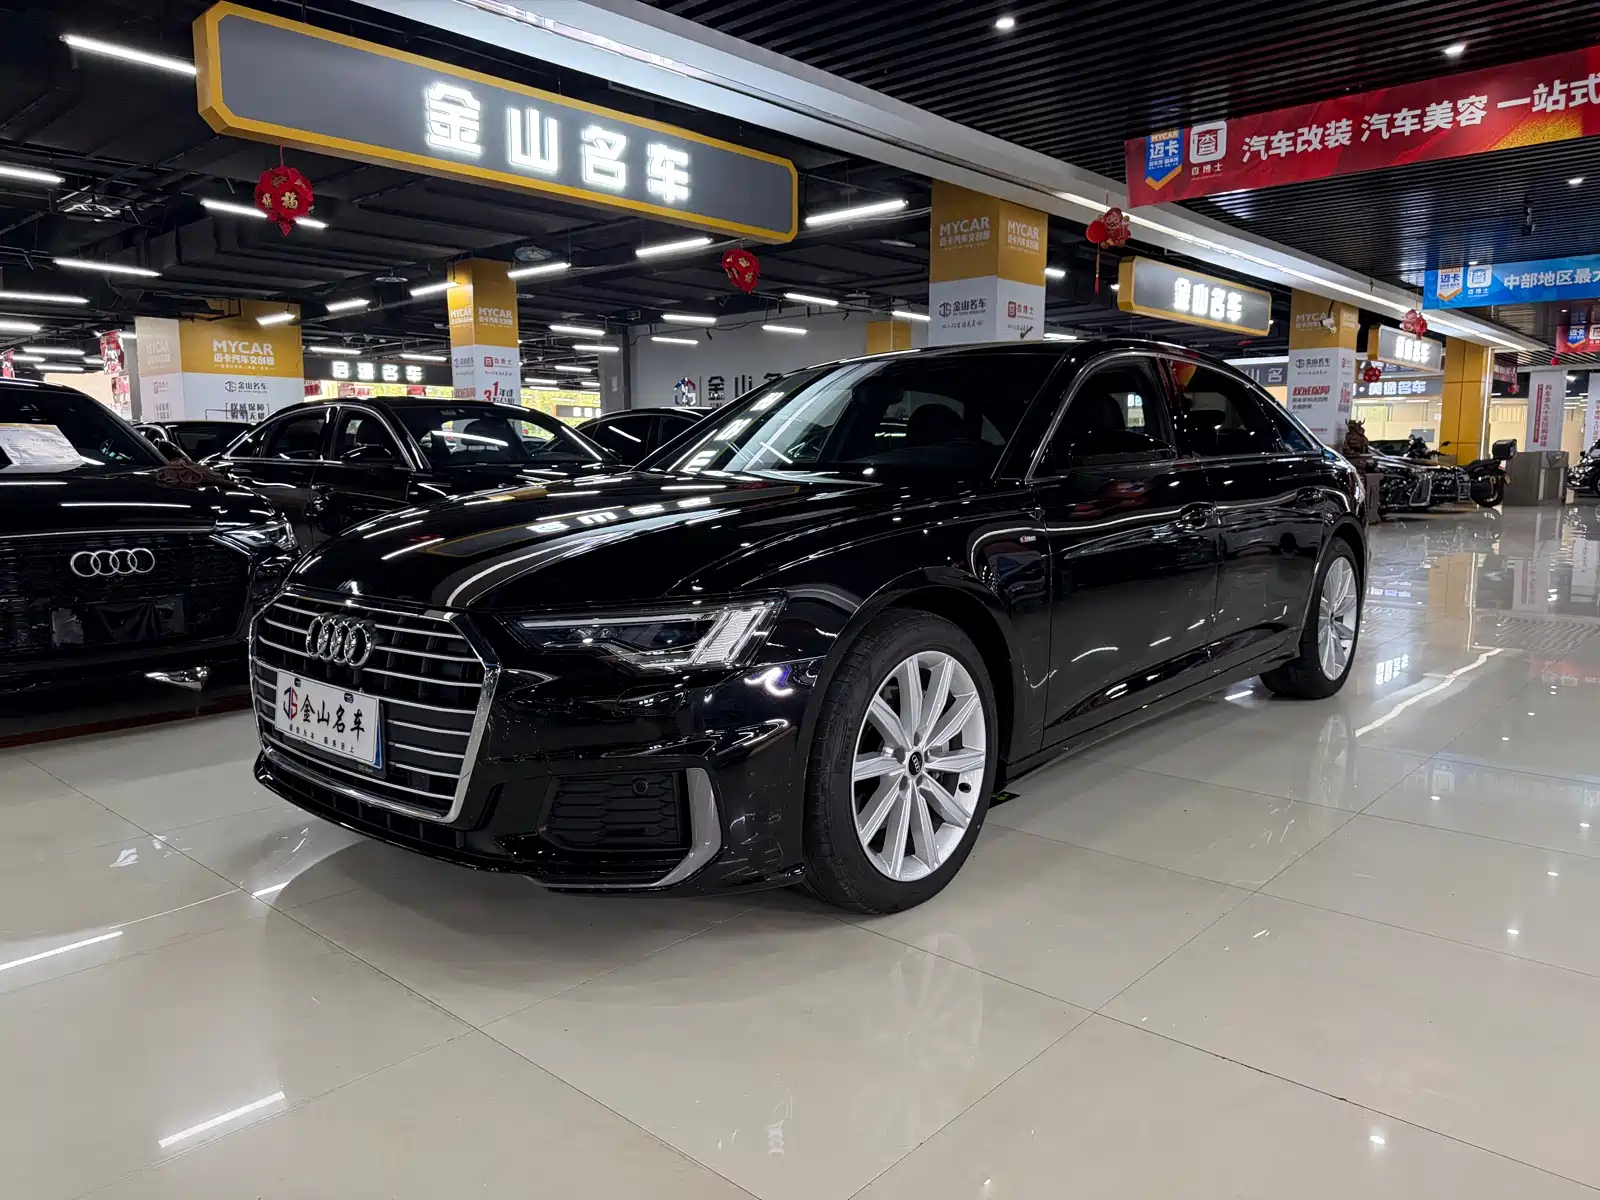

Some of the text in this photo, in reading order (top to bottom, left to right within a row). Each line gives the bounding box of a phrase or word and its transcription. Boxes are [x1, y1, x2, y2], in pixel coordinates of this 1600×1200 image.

[1242, 72, 1600, 162] 汽车改装 汽车美容 一站式
[424, 82, 693, 204] 金山名车
[1151, 129, 1179, 143] MYCAR
[1149, 140, 1179, 160] 迈卡
[940, 216, 990, 236] MYCAR
[1007, 219, 1039, 241] MYCAR
[478, 307, 512, 318] MYCAR
[953, 298, 988, 312] 金山名车
[212, 339, 274, 355] MYCAR
[213, 354, 275, 366] 迈卡汽车文创园
[238, 381, 268, 390] 金山名车
[300, 694, 365, 742] 金山名车
